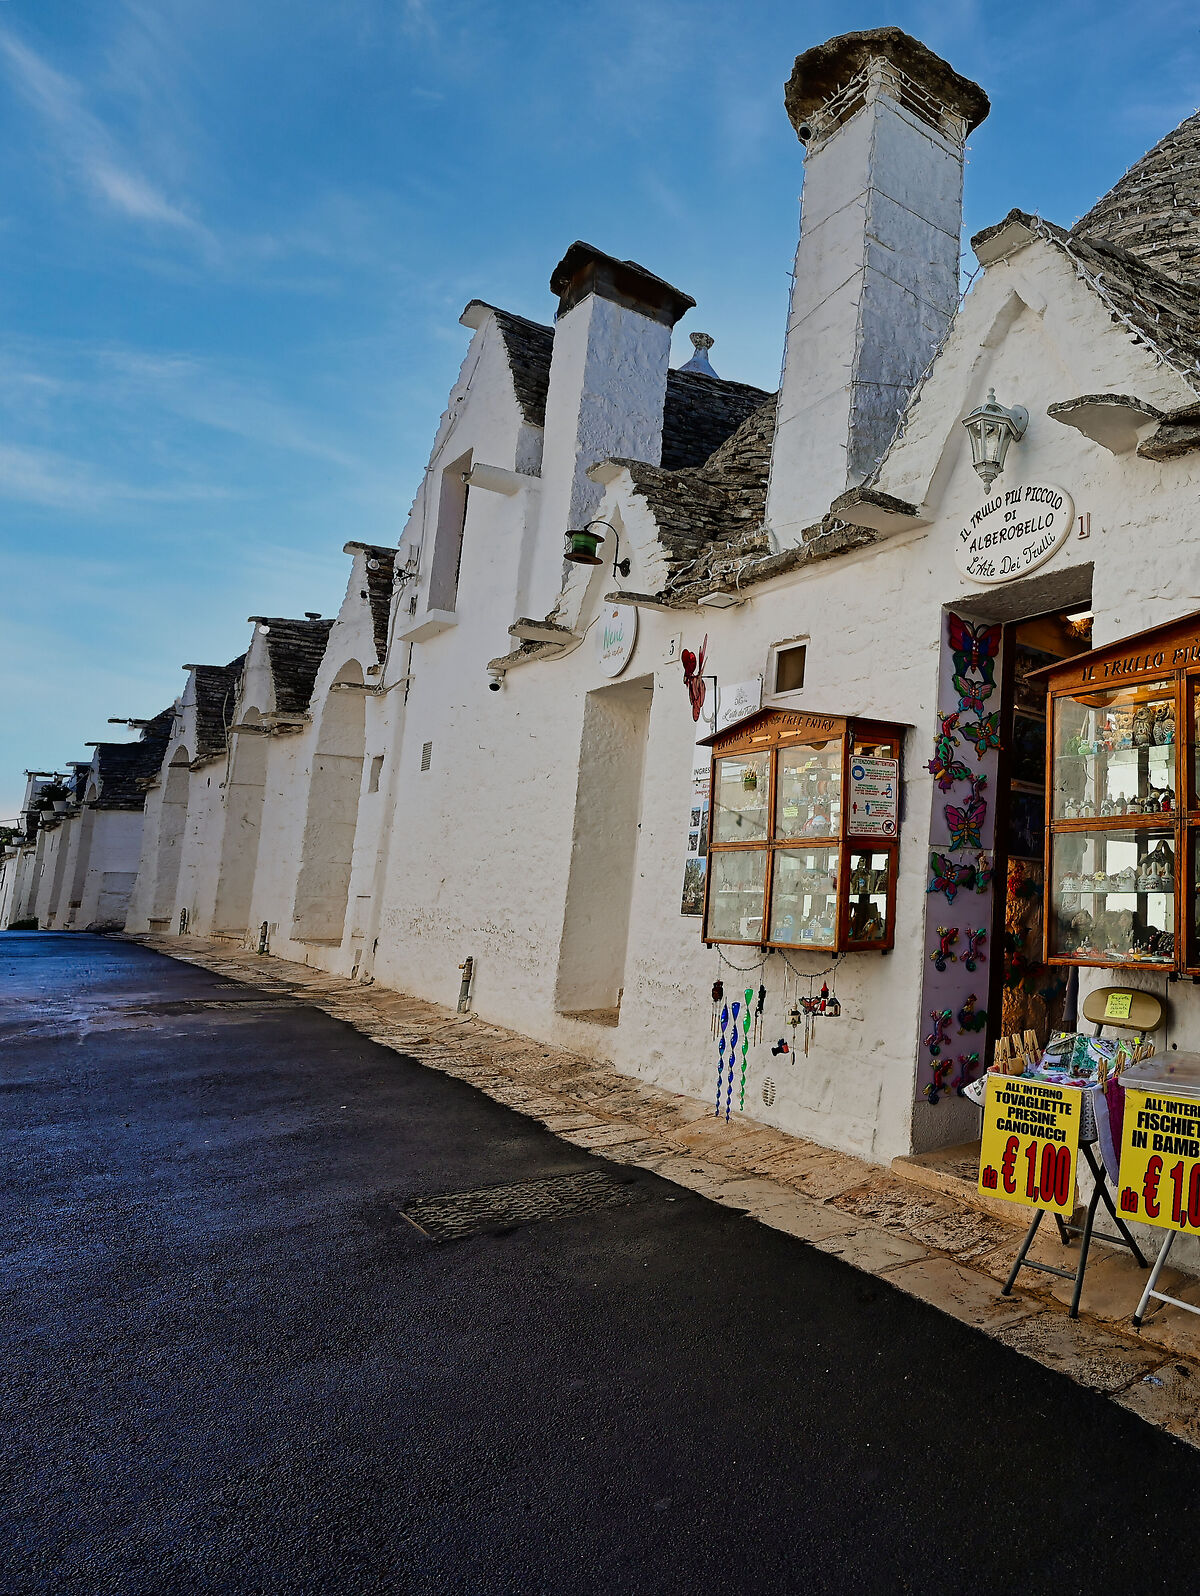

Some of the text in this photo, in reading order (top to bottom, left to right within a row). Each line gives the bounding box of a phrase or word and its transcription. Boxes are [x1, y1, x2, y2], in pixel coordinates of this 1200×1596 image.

[960, 528, 972, 543] IL
[970, 497, 1002, 529] TRULLO
[1025, 486, 1062, 510] PICCOLO
[1004, 509, 1017, 523] DI
[969, 512, 1054, 554] ALBEROBELLO
[999, 555, 1021, 575] Dei
[1022, 532, 1056, 565] Trulli
[1081, 665, 1097, 683] IL
[1102, 652, 1165, 678] TRULLO
[782, 714, 803, 726] FREE
[805, 717, 835, 732] ENTRY
[994, 1090, 1073, 1116] TOVAGLIETTE
[1005, 1081, 1063, 1101] ALL'INTERNO
[1007, 1106, 1057, 1127] PRESINE
[996, 1117, 1067, 1143] CANOVACCI
[1131, 1129, 1148, 1149] IN
[982, 1135, 1072, 1206] da € 1,00
[1120, 1186, 1139, 1213] da
[1142, 1154, 1164, 1218] €
